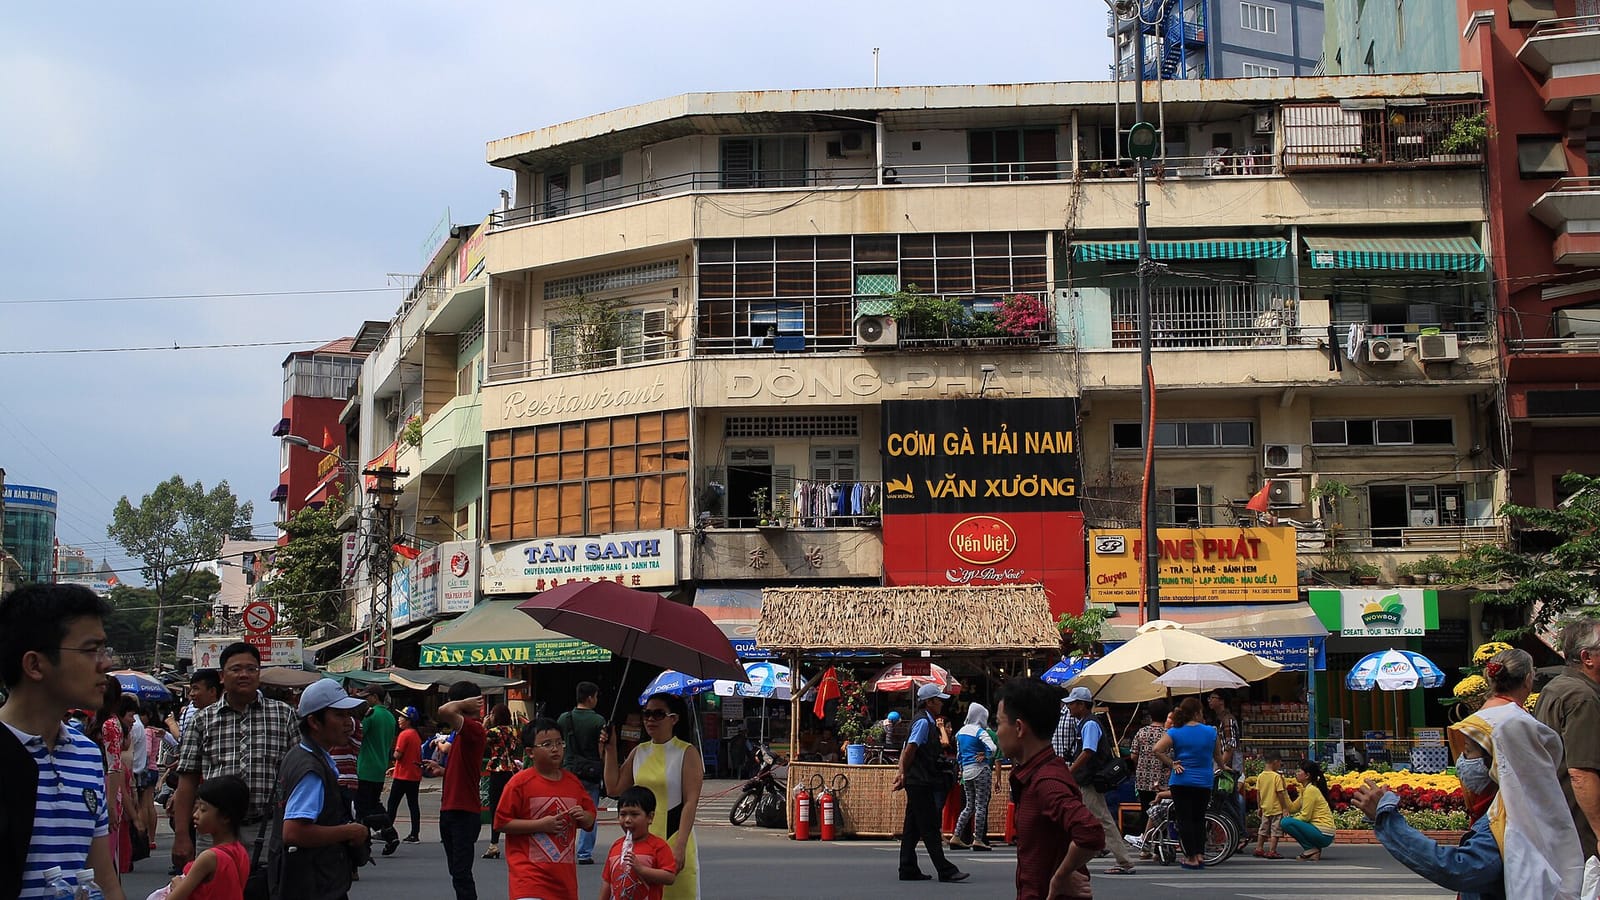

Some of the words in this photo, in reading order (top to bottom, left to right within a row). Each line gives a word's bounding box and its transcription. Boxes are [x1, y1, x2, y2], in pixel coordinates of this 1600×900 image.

[503, 374, 665, 420] Restaurant
[886, 430, 936, 457] CƠM
[943, 427, 975, 456] GÀ
[982, 424, 1018, 455] HẢI
[1025, 431, 1073, 454] NAM
[926, 473, 977, 499] VĂN
[984, 474, 1076, 498] XƯƠNG
[523, 541, 576, 564] TÂN
[585, 539, 660, 561] SANH
[956, 533, 980, 552] Yến
[983, 533, 1009, 554] Việt
[1203, 534, 1261, 559] PHÁT
[1096, 571, 1128, 586] Chuyên
[1170, 565, 1184, 574] TRÀ
[1192, 565, 1201, 573] CÀ
[1203, 565, 1216, 573] PHÊ
[1223, 565, 1241, 573] BÁNH
[1242, 565, 1257, 573] KEM
[1365, 613, 1398, 622] WOWBOX
[1343, 628, 1364, 636] CREATE
[1367, 628, 1382, 636] YOUR
[1259, 639, 1284, 648] PHÁT
[423, 646, 466, 663] TÂN
[470, 646, 531, 663] SANH
